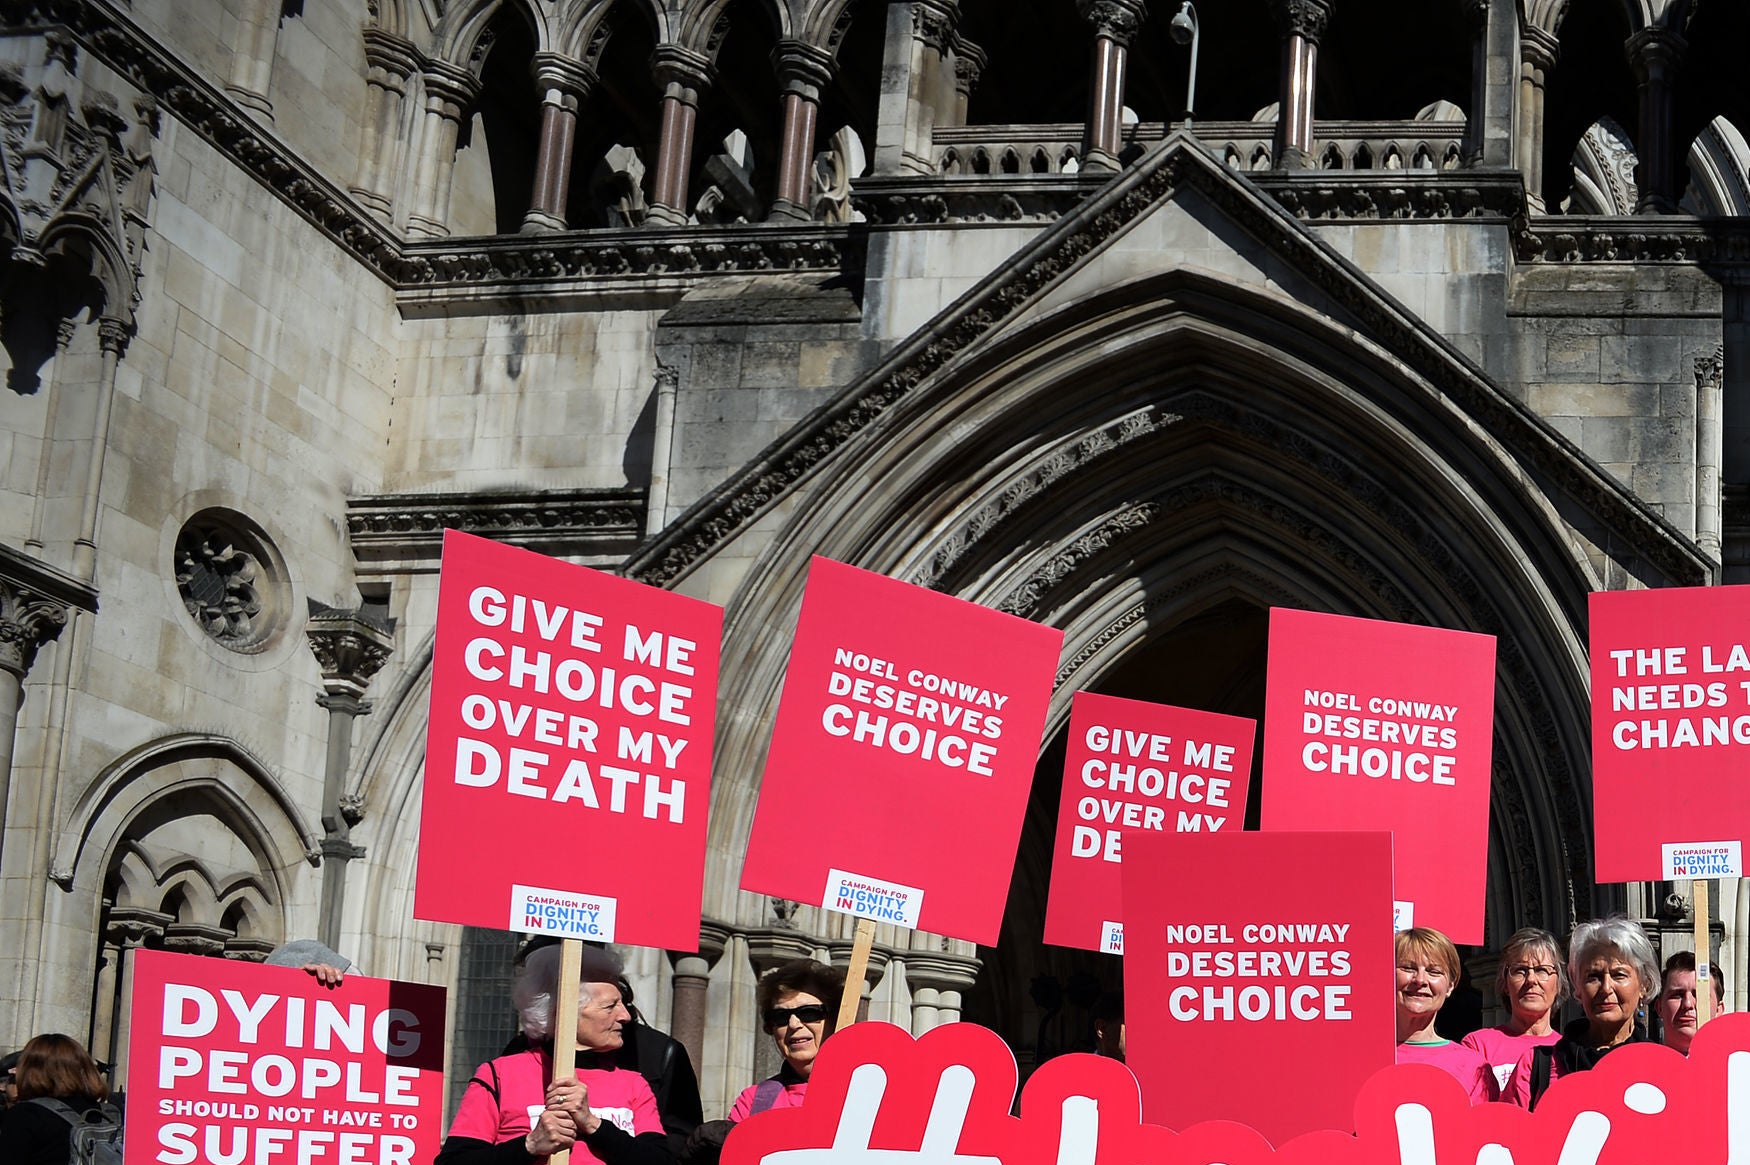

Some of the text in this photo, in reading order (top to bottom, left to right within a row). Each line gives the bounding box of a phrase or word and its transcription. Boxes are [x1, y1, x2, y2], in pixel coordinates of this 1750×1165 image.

[469, 587, 696, 676] GIVE ME
[835, 648, 1008, 710] NOEL CONWAY
[1610, 648, 1687, 676] THE
[465, 638, 692, 726] CHOICE
[1613, 683, 1727, 711] NEEDS
[829, 672, 1003, 738] DESERVES
[1305, 690, 1458, 722] NOEL CONWAY
[462, 695, 688, 768] OVER MY
[823, 704, 997, 776] CHOICE
[1304, 712, 1456, 749] DESERVES
[1085, 726, 1236, 773] GIVE ME
[1302, 742, 1456, 785] CHOICE
[455, 737, 685, 823] DEATH
[1080, 760, 1231, 808] CHOICE
[1077, 796, 1165, 832] OVER
[1674, 855, 1728, 865] DIGNITY
[1674, 865, 1733, 875] IN DYING.
[526, 895, 599, 911] CAMPAIGN FOR
[838, 886, 904, 910] DIGNITY
[840, 879, 907, 900] CAMPAIGN FOR
[524, 916, 603, 936] IN DYING.
[526, 903, 597, 922] DIGNITY
[836, 897, 908, 923] IN DYING.
[1167, 924, 1349, 943] NOEL CONWAY
[1168, 951, 1351, 976] DESERVES
[163, 983, 420, 1057] DYING
[1169, 985, 1352, 1021] CHOICE
[159, 1046, 420, 1106] PEOPLE
[159, 1099, 417, 1129] SHOULD NOT HAVE TO
